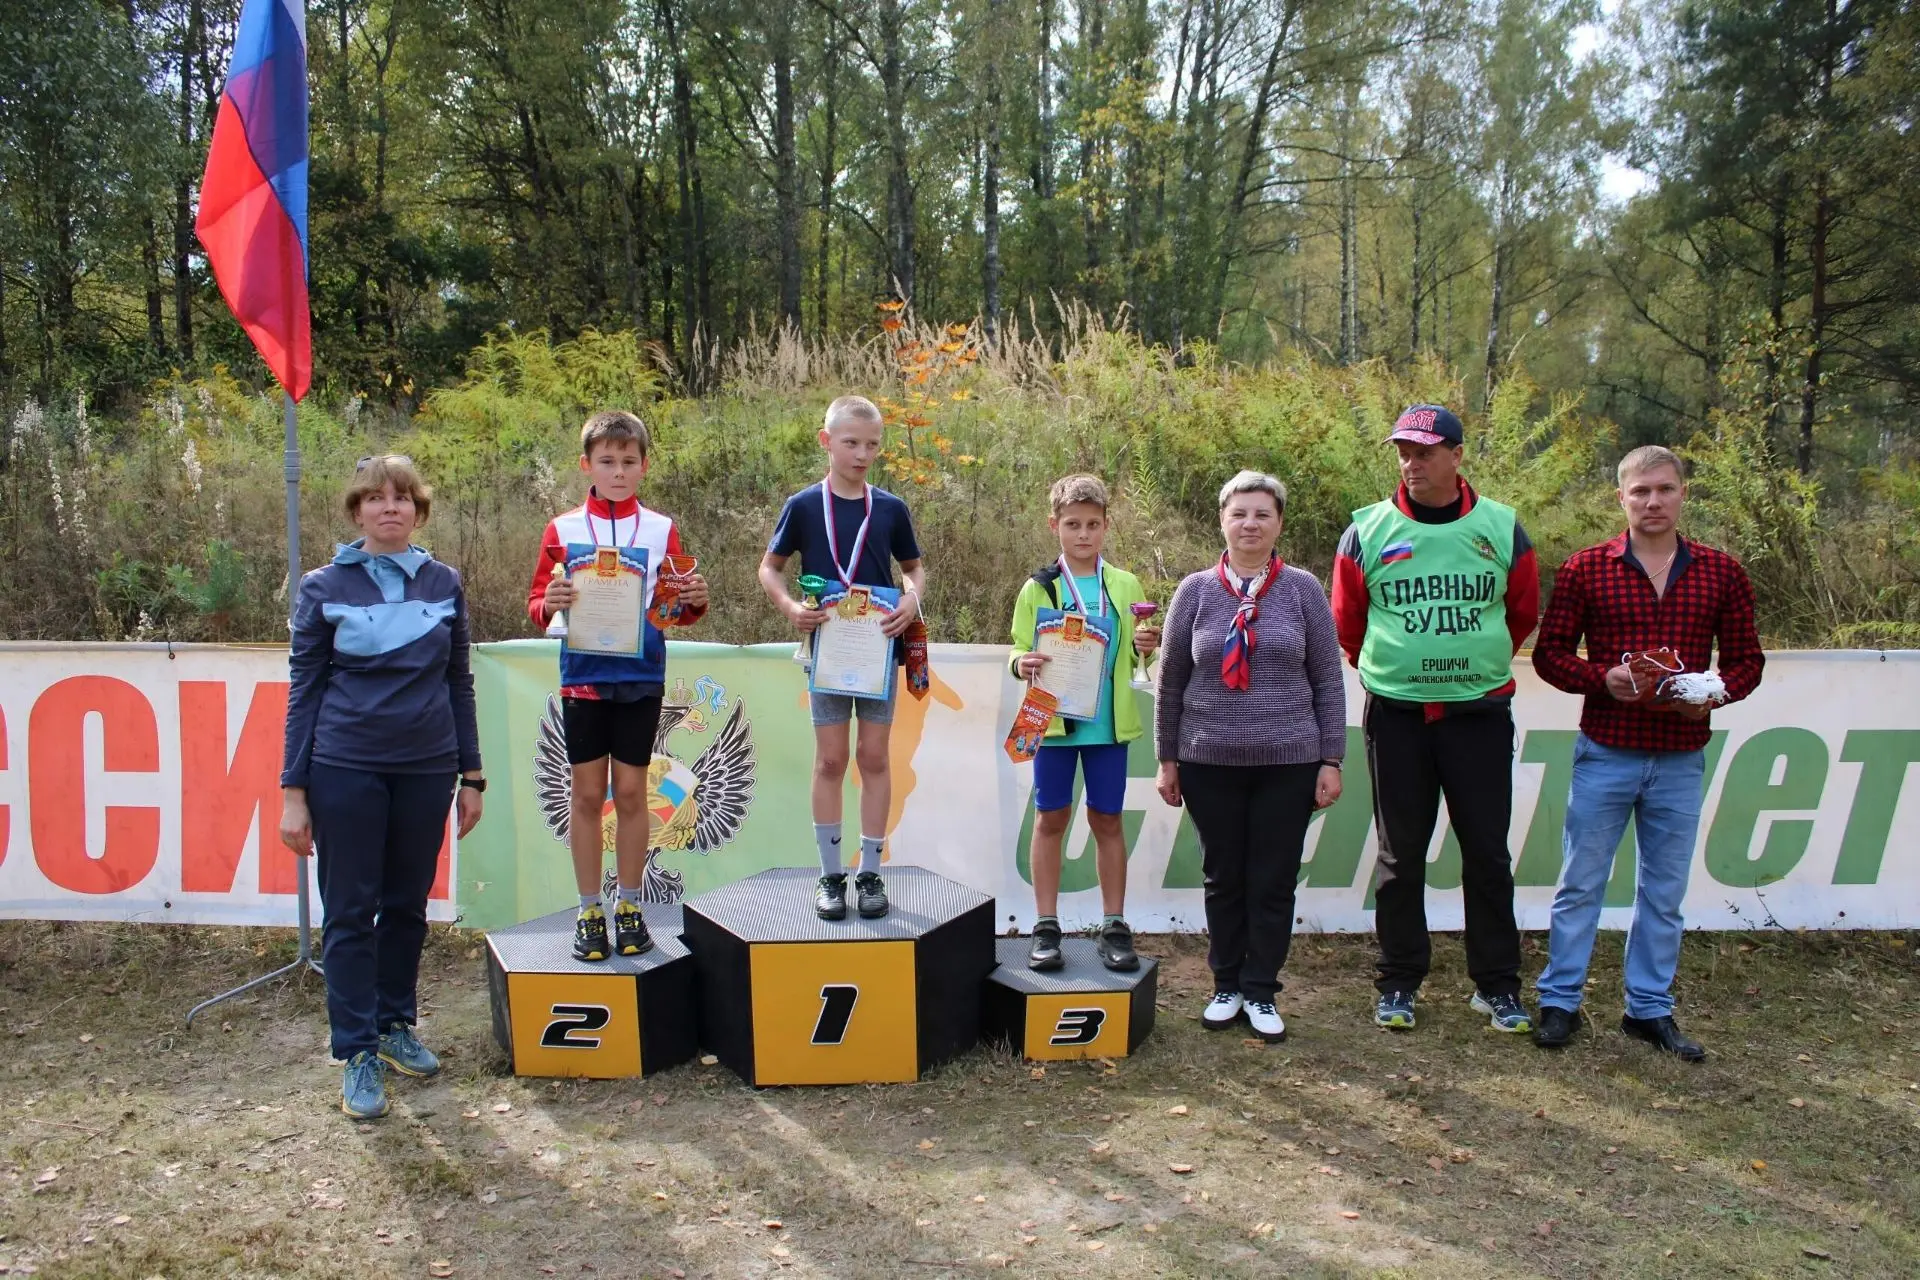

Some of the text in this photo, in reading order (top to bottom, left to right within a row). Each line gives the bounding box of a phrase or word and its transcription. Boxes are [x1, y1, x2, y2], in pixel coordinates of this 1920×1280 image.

[583, 575, 630, 587] ГРАМОТА
[1380, 571, 1495, 608] ГЛАВНЫЙ
[1402, 607, 1482, 636] СУДЬЯ
[1407, 673, 1482, 684] СМОЛЕНСКАЯ ОБЛАСТЬ
[1422, 657, 1469, 671] ЕРШИЧИ
[1023, 704, 1049, 721] КРОСС
[0, 675, 454, 900] СИ
[540, 1003, 611, 1049] 2
[811, 984, 859, 1046] 1
[1049, 1007, 1107, 1046] 3
